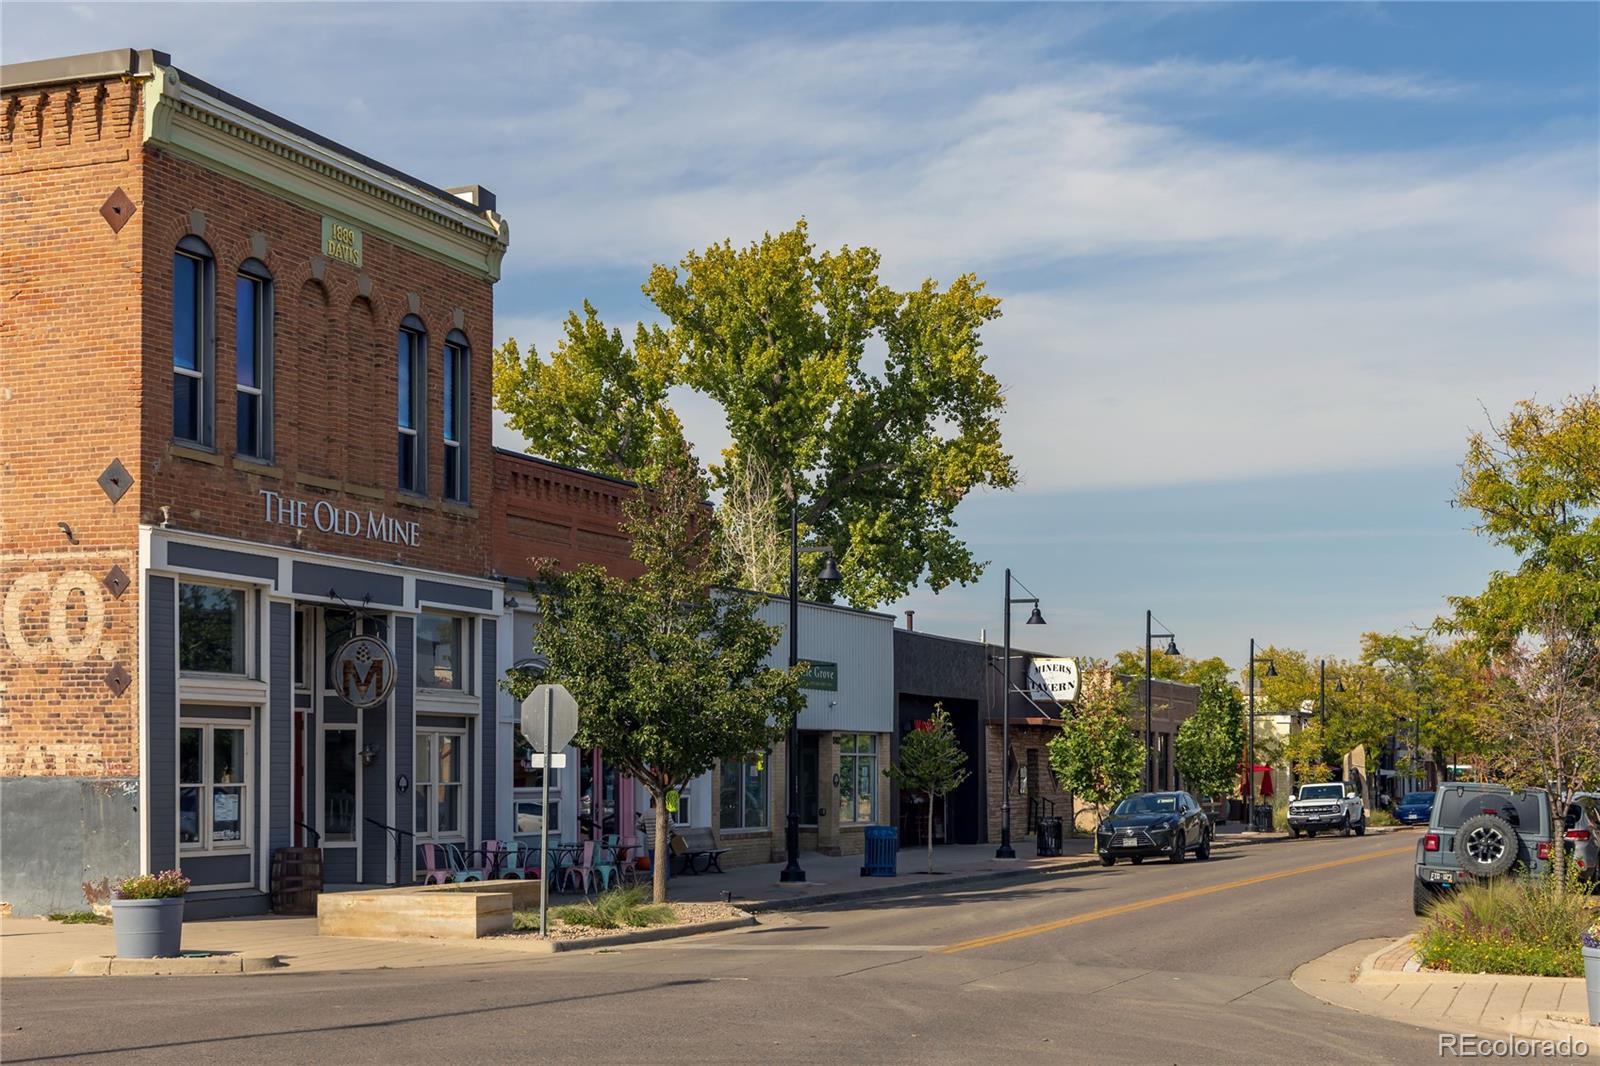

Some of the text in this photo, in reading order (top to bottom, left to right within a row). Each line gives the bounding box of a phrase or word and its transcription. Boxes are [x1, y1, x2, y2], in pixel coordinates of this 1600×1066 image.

[332, 223, 355, 246] 1889
[327, 239, 359, 265] DAVIS
[341, 657, 385, 697] M
[814, 666, 834, 680] Grove
[1034, 663, 1072, 675] MINERS
[1031, 680, 1075, 692] TAVERN
